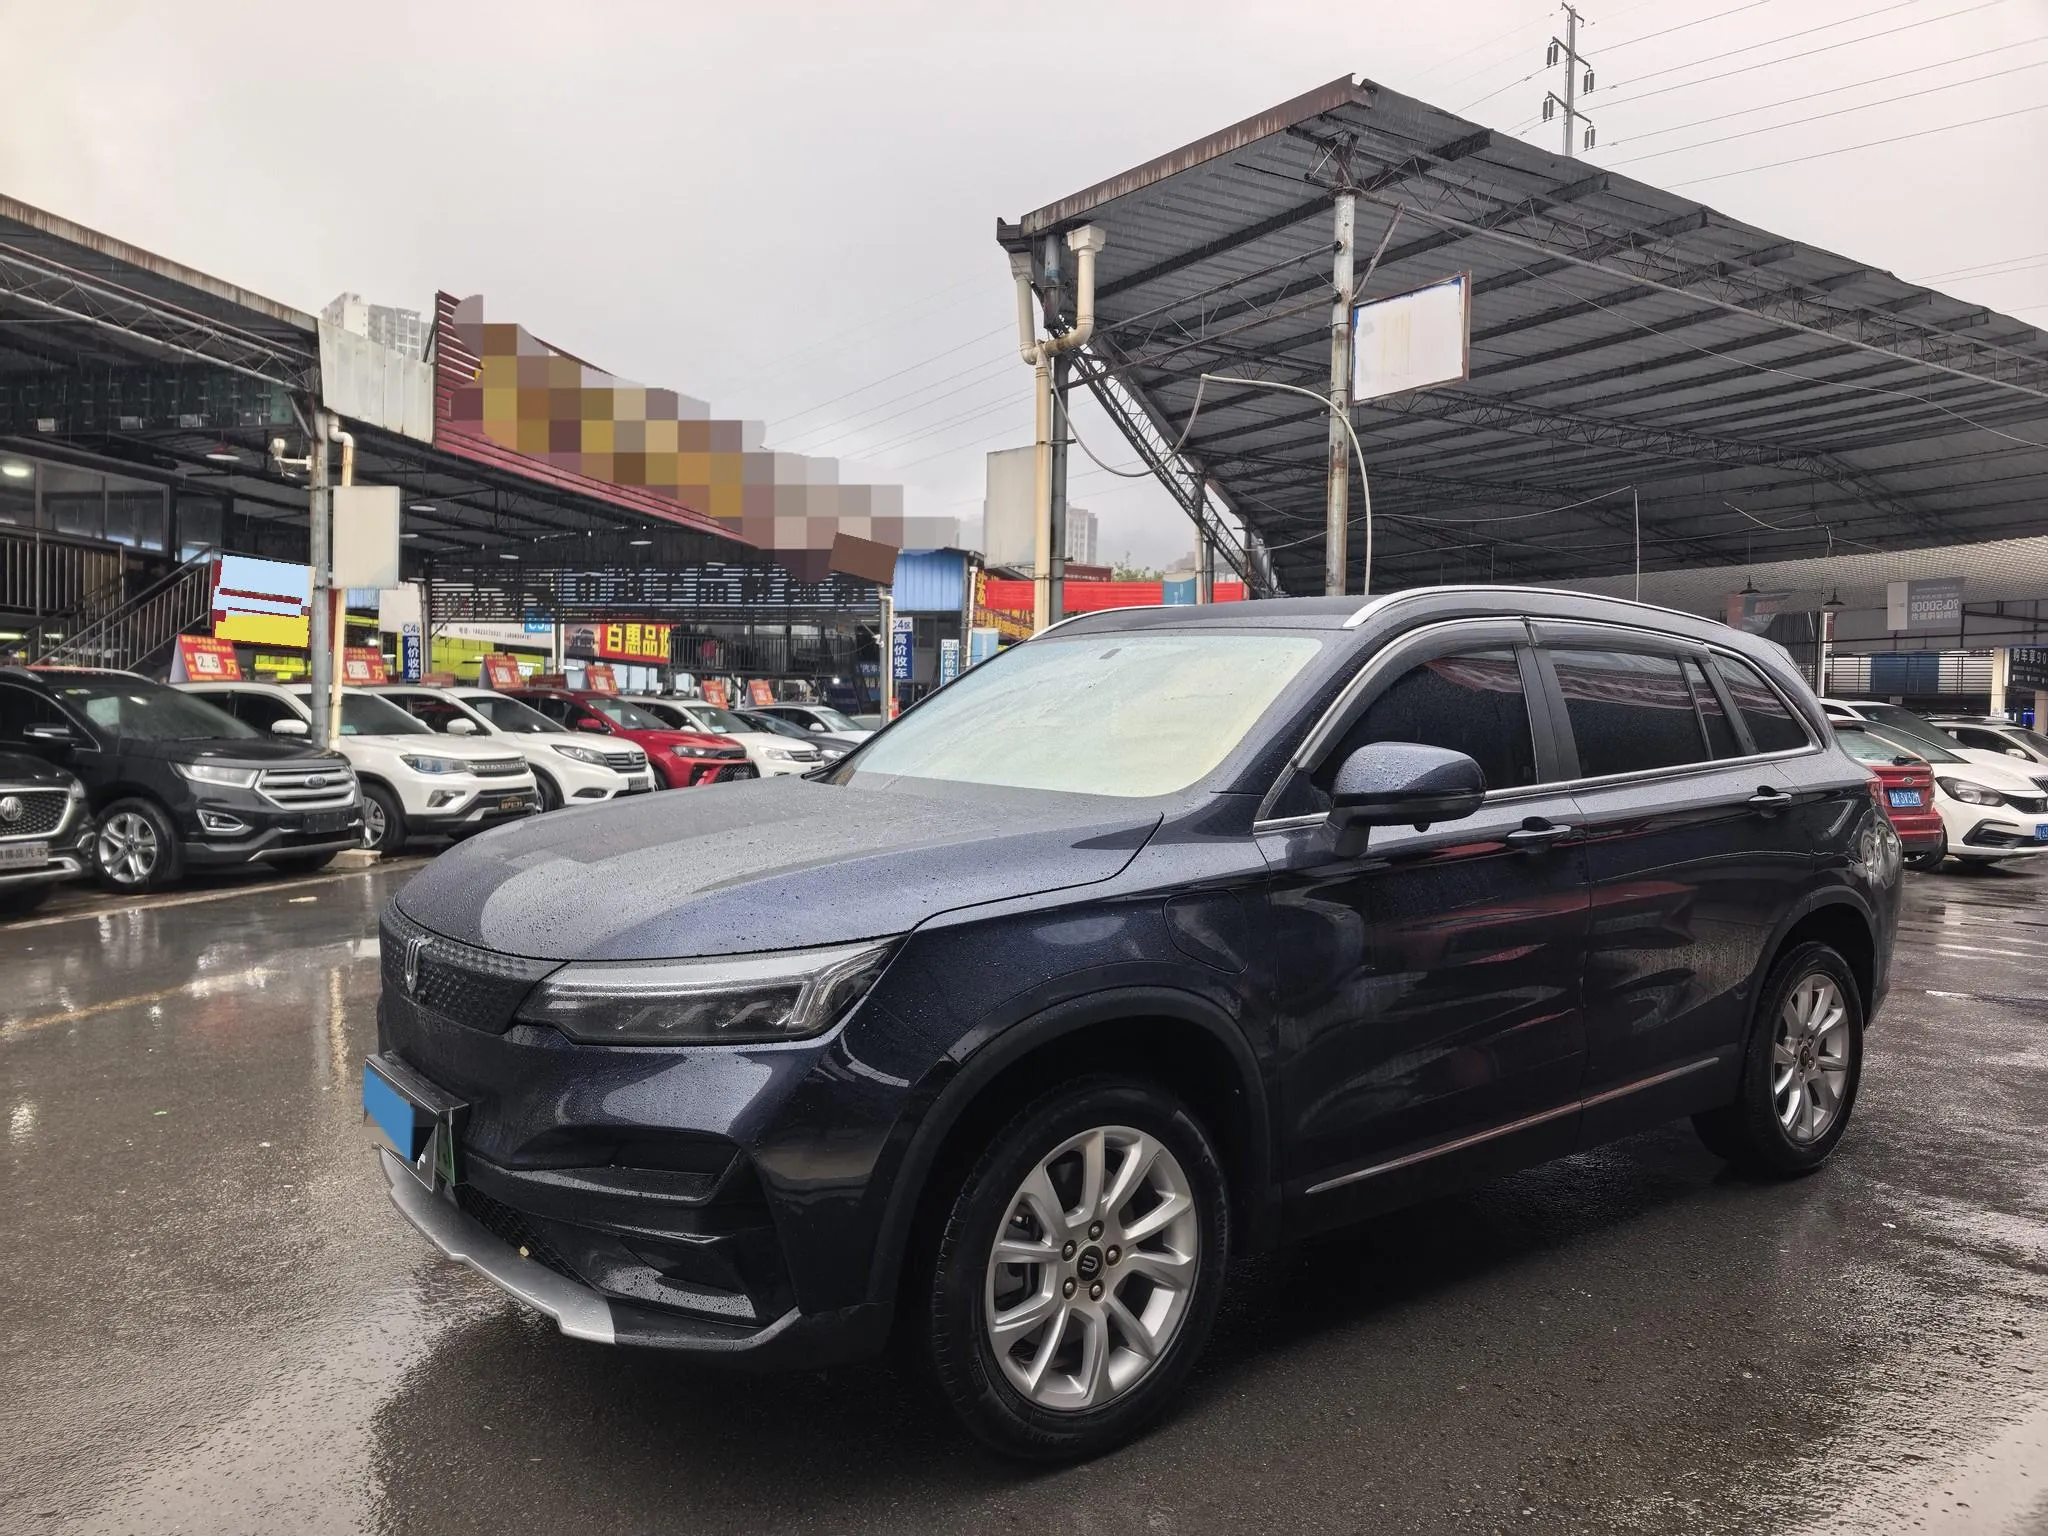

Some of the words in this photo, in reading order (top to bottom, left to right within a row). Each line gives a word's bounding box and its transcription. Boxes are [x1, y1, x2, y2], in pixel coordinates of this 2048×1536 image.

[198, 655, 219, 669] 2.5
[223, 658, 239, 676] 万
[407, 636, 420, 679] 高价收车
[894, 633, 908, 679] 高价收车
